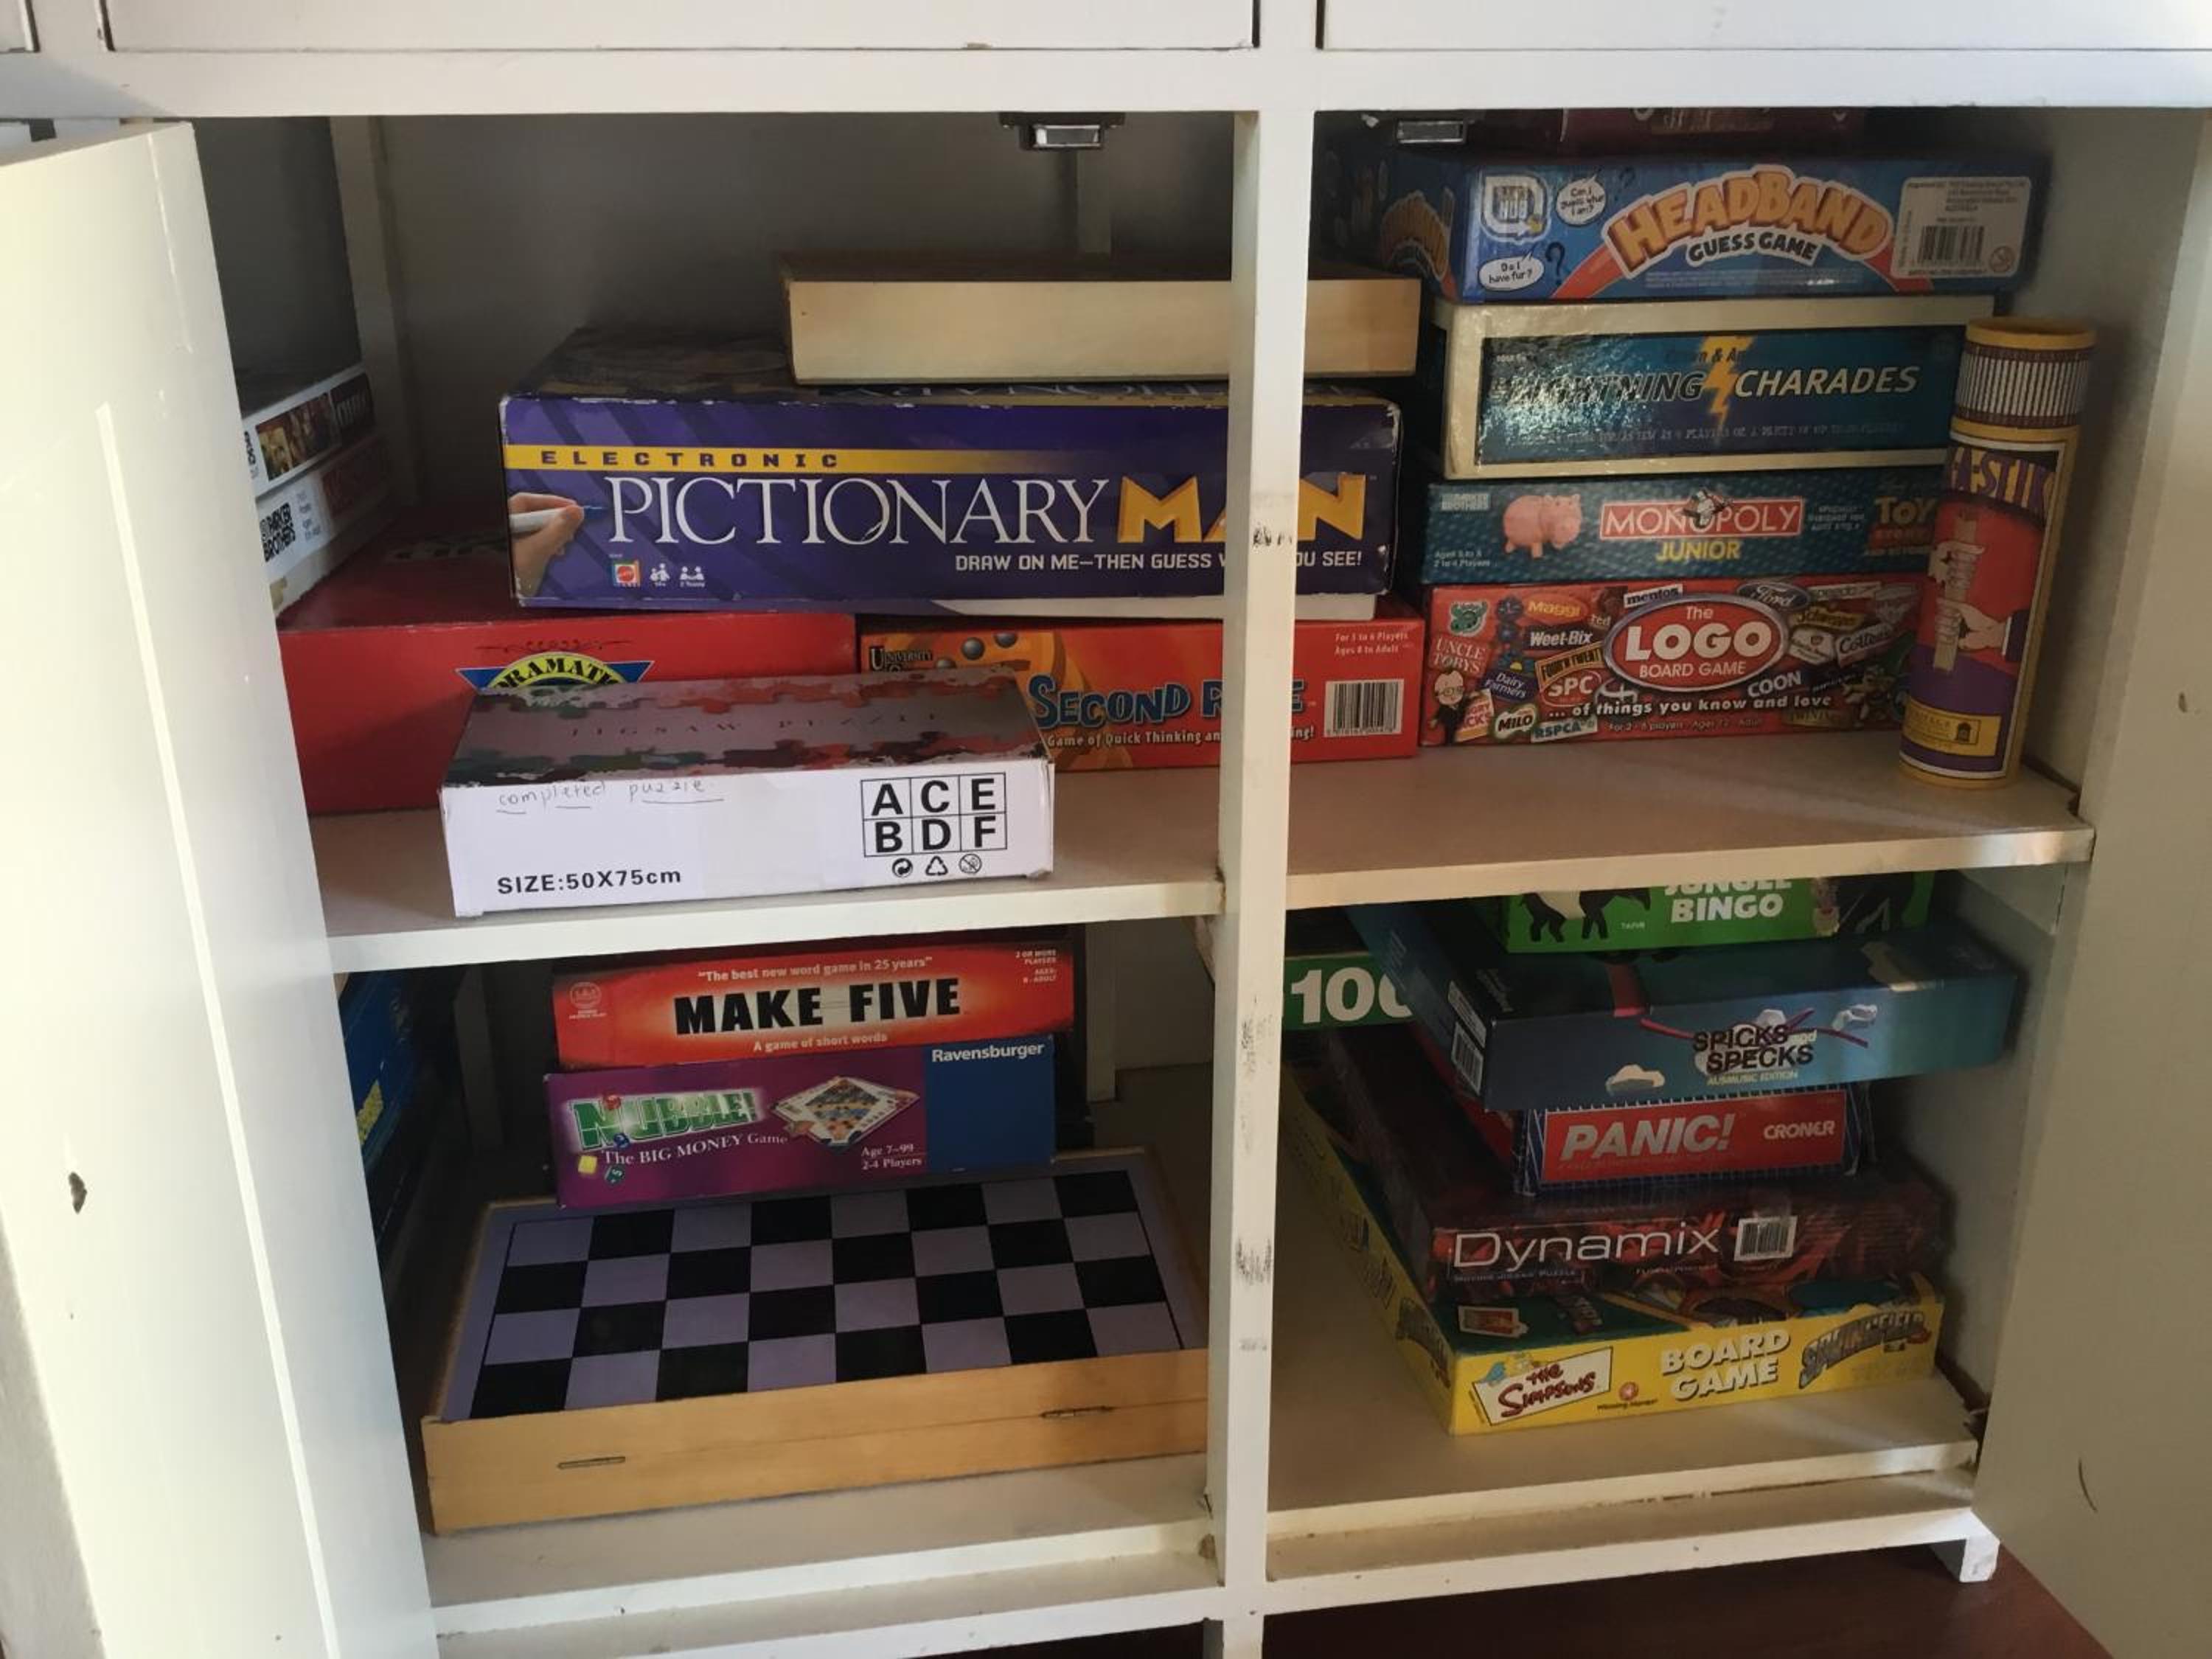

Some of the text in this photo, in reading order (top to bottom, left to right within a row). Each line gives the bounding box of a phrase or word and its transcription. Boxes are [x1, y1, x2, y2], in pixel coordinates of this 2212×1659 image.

[1607, 170, 1890, 273] HEADBAND
[1688, 232, 1818, 262] GUESS GAME
[1735, 366, 1920, 397] CHARADES
[540, 451, 839, 469] ELECTRONIC
[605, 475, 1366, 546] PICTIONARY MN
[1604, 503, 1798, 534] MONOPOLY
[1321, 551, 1363, 566] SEE!
[1656, 540, 1743, 561] JUNIOR
[956, 554, 1010, 571] DRAW
[1018, 554, 1044, 570] ON
[1152, 554, 1211, 569] GUESS
[1627, 588, 1679, 605] mentos
[1756, 585, 1795, 607] Ford
[1527, 600, 1581, 617] Maggi
[1685, 605, 1714, 620] The
[1437, 636, 1486, 659] UNCLE
[1530, 630, 1593, 647] Weet-Bix
[1625, 621, 1772, 661] LOGO
[1334, 645, 1355, 656] Ages
[1496, 672, 1525, 689] Dairy
[1639, 661, 1747, 678] BOARD GAME
[1548, 675, 1593, 697] SPC
[1747, 670, 1802, 698] COON
[1028, 674, 1192, 728] SECOND
[1573, 703, 1594, 717] of
[1596, 701, 1652, 716] things
[1659, 700, 1692, 714] you
[1698, 698, 1747, 711] know
[1753, 695, 1787, 708] and
[1794, 695, 1832, 706] love
[1498, 714, 1533, 731] MILO
[1047, 735, 1083, 748] Game
[1088, 734, 1102, 746] of
[1106, 732, 1141, 745] Quick
[1145, 729, 1201, 745] Thinking
[499, 781, 606, 807] completed
[870, 778, 996, 816] A C E
[875, 815, 996, 853] B D F
[498, 869, 681, 894] SIZE:50X75cm
[1671, 893, 1784, 923] BINGO
[731, 968, 755, 981] best
[762, 968, 785, 978] new
[788, 964, 820, 976] word
[822, 963, 857, 977] game
[859, 961, 872, 973] in
[874, 959, 891, 971] 25
[674, 977, 961, 1035] MAKE FIVE
[754, 1033, 888, 1054] A game of short words
[1693, 1024, 1788, 1051] SPICKS
[931, 1043, 1045, 1062] Ravensburger
[1706, 1045, 1814, 1074] SPECKS
[1560, 1113, 1836, 1161] PANIC! CRONER
[603, 1133, 788, 1166] The BIG MONEY Game
[862, 1146, 883, 1158] Age
[883, 1158, 922, 1169] Players
[1454, 1222, 1720, 1273] Dynamix
[1660, 1328, 1791, 1376] BOARD
[1526, 1363, 1564, 1386] THE
[1670, 1357, 1778, 1401] GAME
